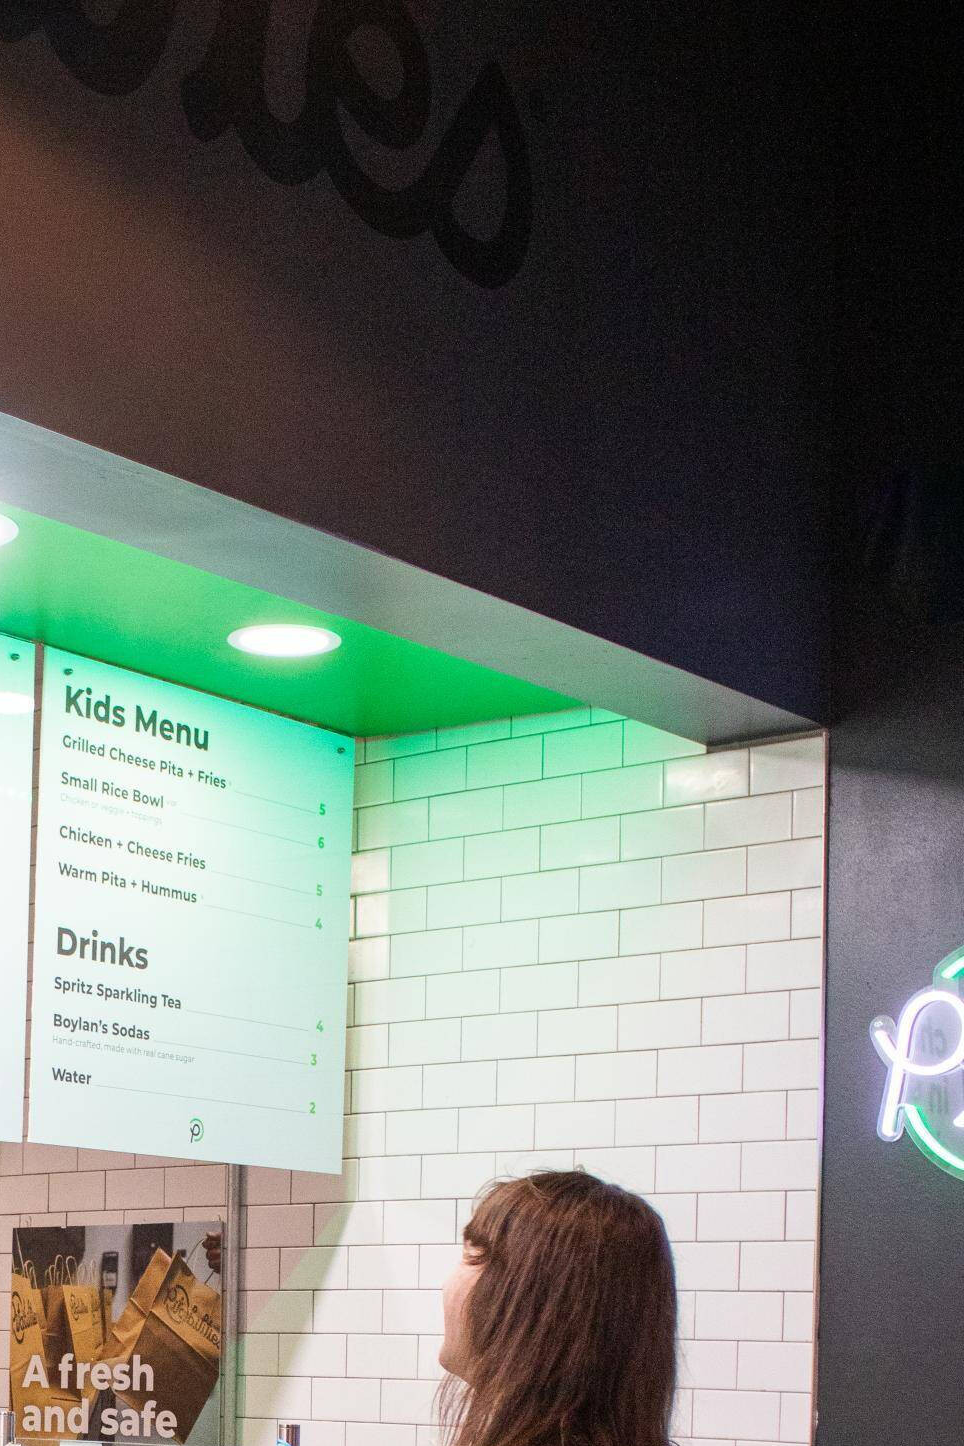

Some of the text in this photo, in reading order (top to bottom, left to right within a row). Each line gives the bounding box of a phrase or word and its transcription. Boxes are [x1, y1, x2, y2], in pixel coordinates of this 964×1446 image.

[65, 685, 209, 751] Kids Menu
[62, 734, 227, 789] Grilled Cheese Pita Fries
[61, 771, 164, 808] Small Rice Bowl
[319, 803, 326, 816] 5
[59, 825, 206, 871] Chicken Cheese Fries
[317, 836, 325, 849] 6
[58, 862, 197, 904] Warm Pita Hummus
[316, 883, 323, 896] 5
[315, 918, 323, 930] 4
[57, 926, 148, 970] Drinks
[54, 976, 182, 1010] Spritz Sparkling Tea
[53, 1013, 150, 1041] Boylan's Sodas
[316, 1020, 324, 1033] 4
[52, 1035, 103, 1051] Hand-crafted,
[104, 1043, 125, 1054] made
[126, 1046, 142, 1056] with
[157, 1051, 174, 1061] cane
[310, 1053, 318, 1066] 3
[52, 1067, 92, 1085] Water
[309, 1101, 317, 1114] 2
[22, 1353, 154, 1392] A fresh
[23, 1399, 178, 1438] and safe
